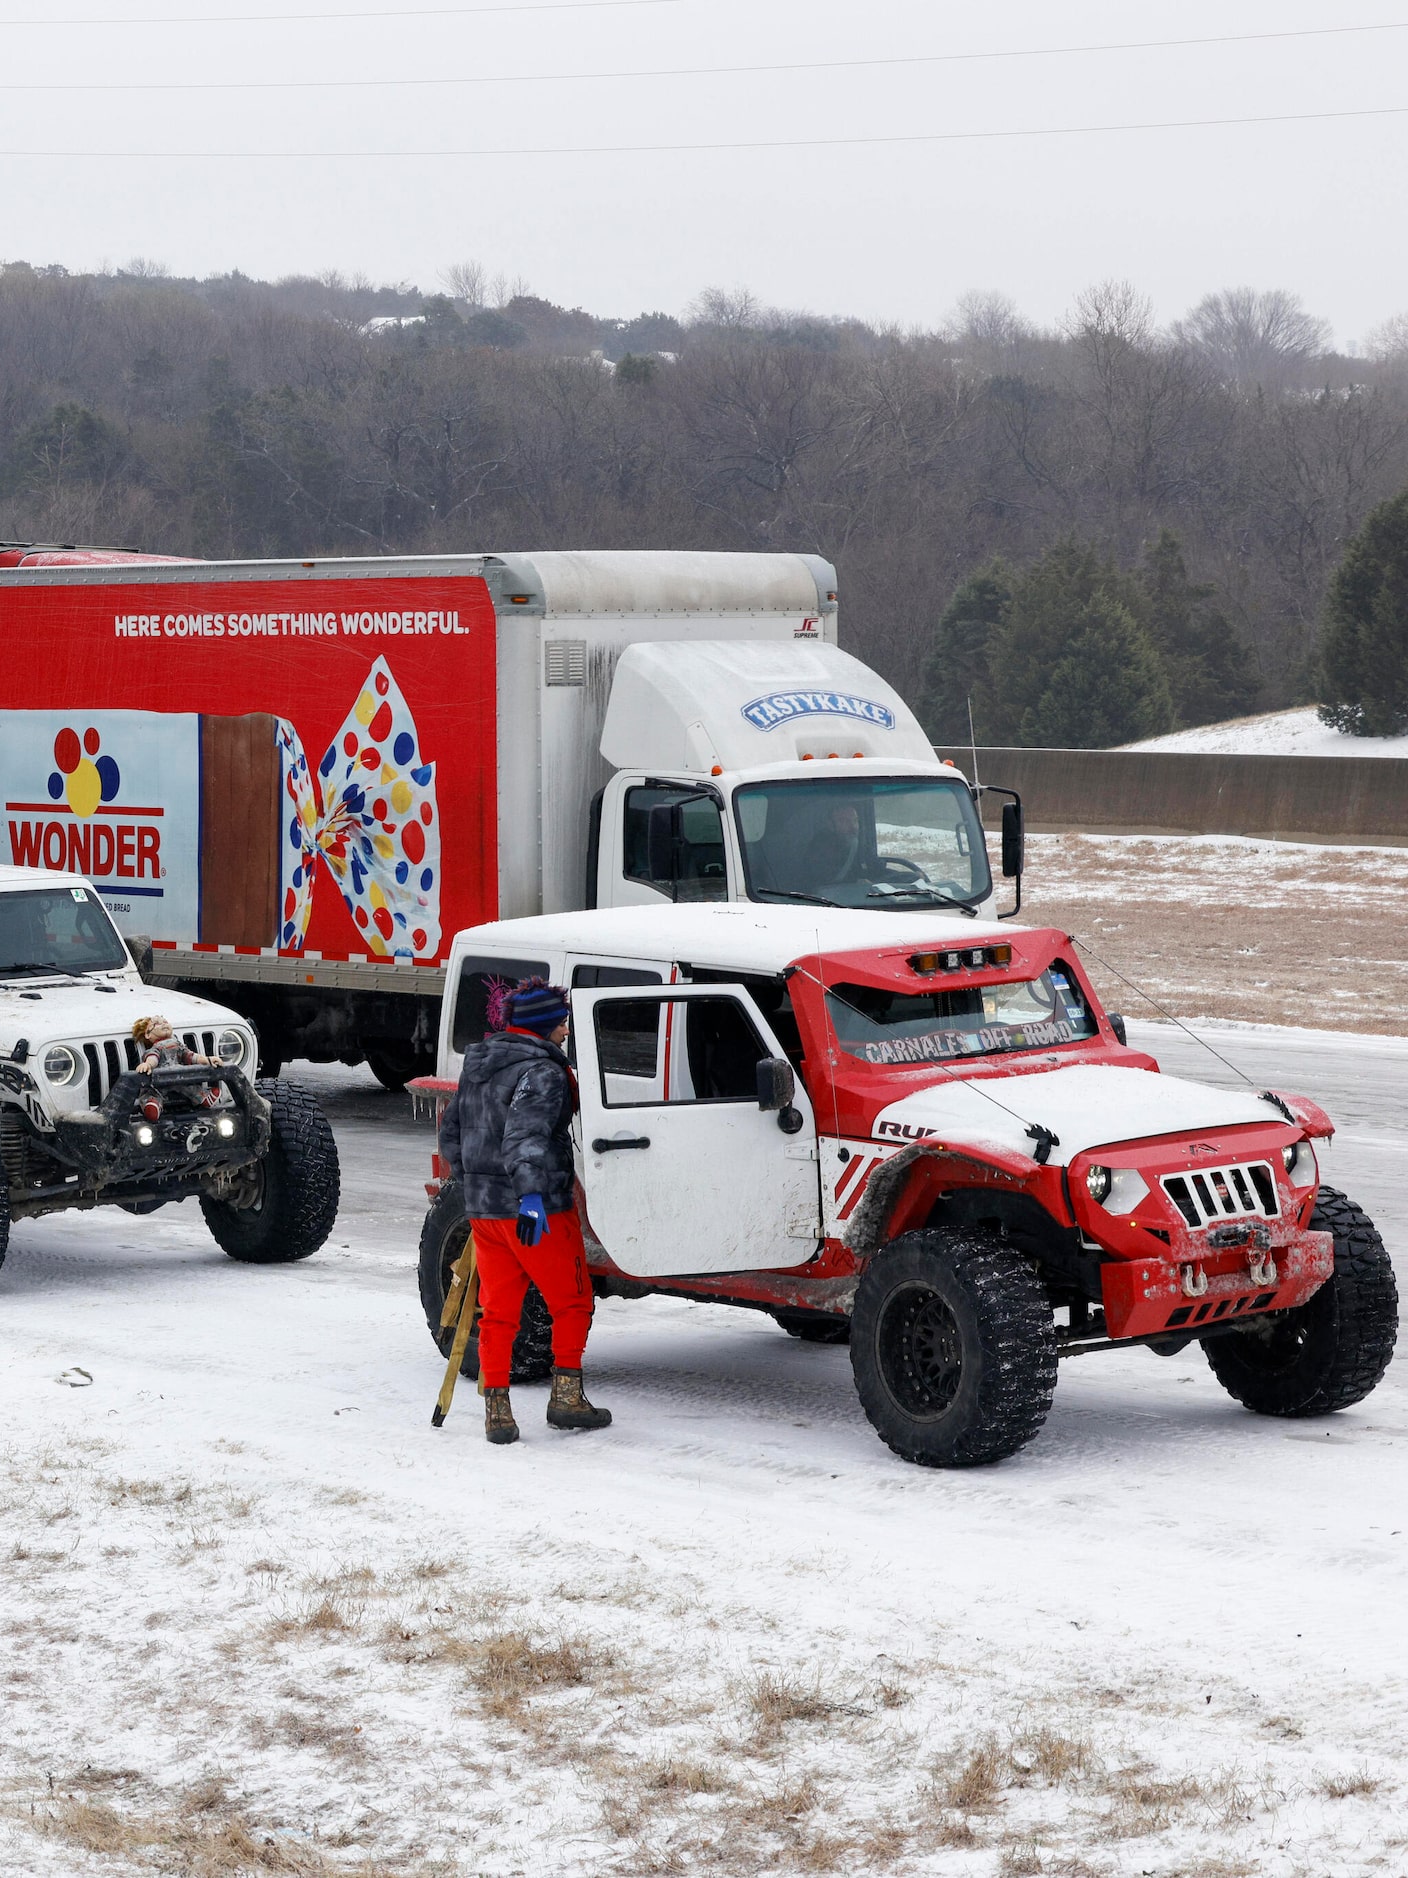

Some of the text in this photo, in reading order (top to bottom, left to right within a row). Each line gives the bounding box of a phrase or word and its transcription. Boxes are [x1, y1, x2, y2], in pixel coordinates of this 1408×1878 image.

[115, 611, 470, 637] HERE COMES SOMETHING WONDERFUL.
[747, 692, 888, 727] TASTYKAKE
[8, 821, 161, 879] WONDER
[113, 903, 131, 913] BREAD
[865, 1021, 1074, 1064] CARNALES OFF ROAD
